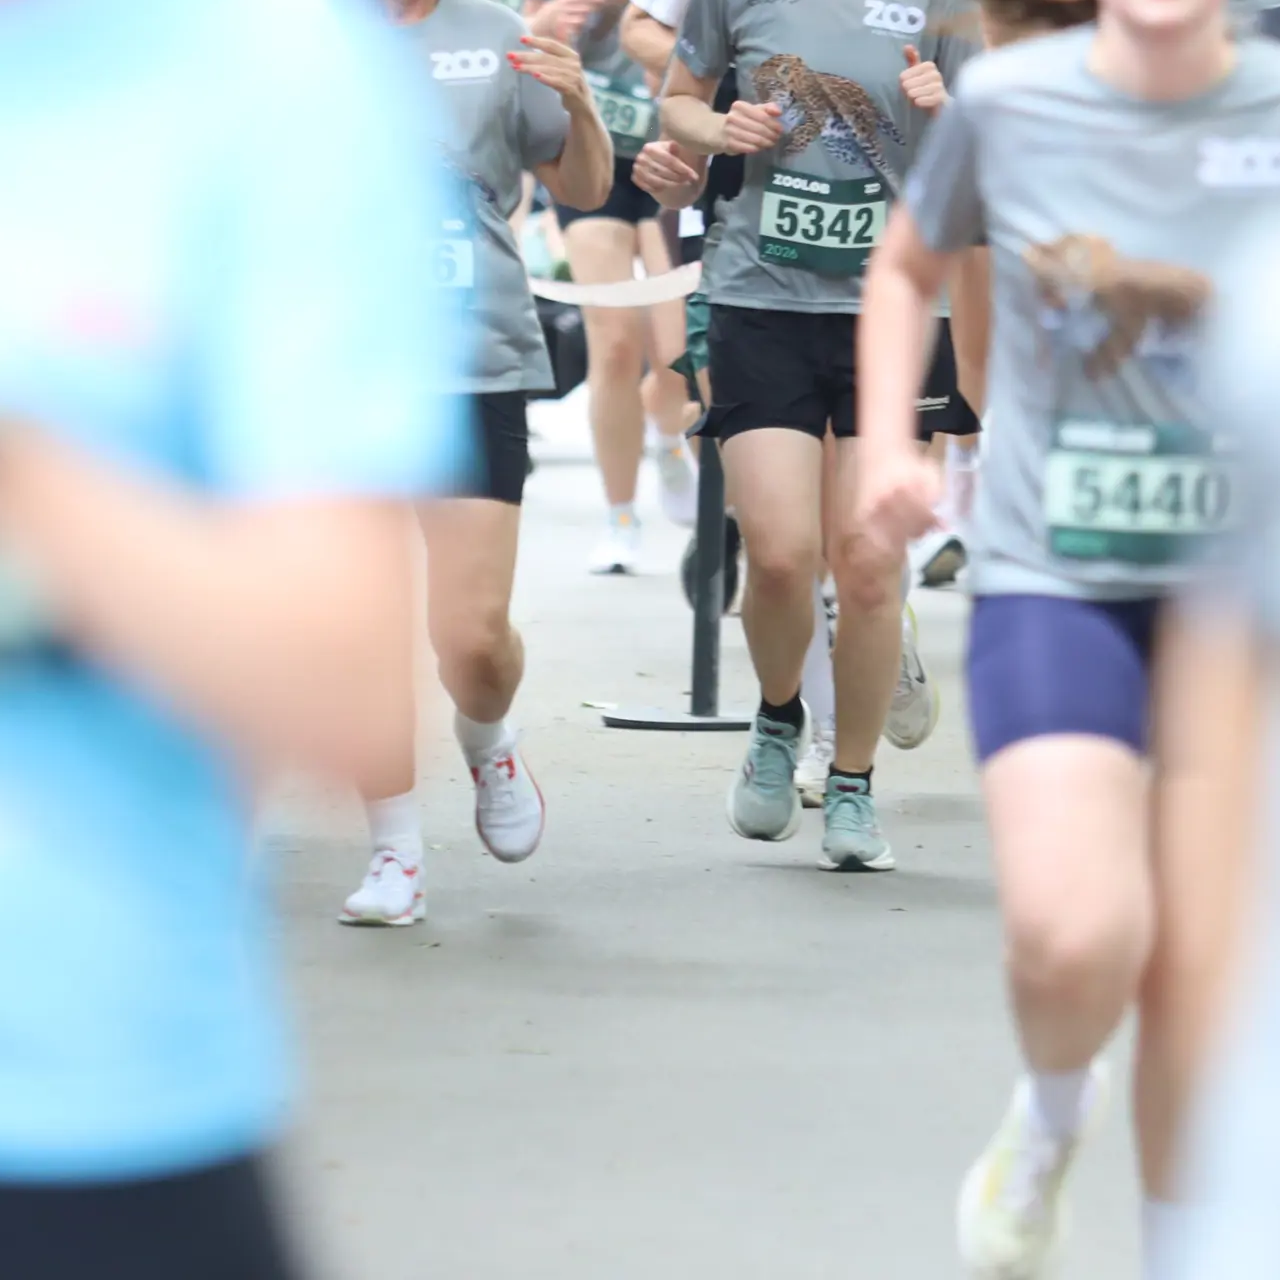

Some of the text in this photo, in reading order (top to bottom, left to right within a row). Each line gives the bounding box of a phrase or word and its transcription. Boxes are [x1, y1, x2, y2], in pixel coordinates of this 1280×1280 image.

[430, 49, 500, 80] ZOO
[774, 199, 874, 245] 5342
[1072, 467, 1232, 526] 5440
